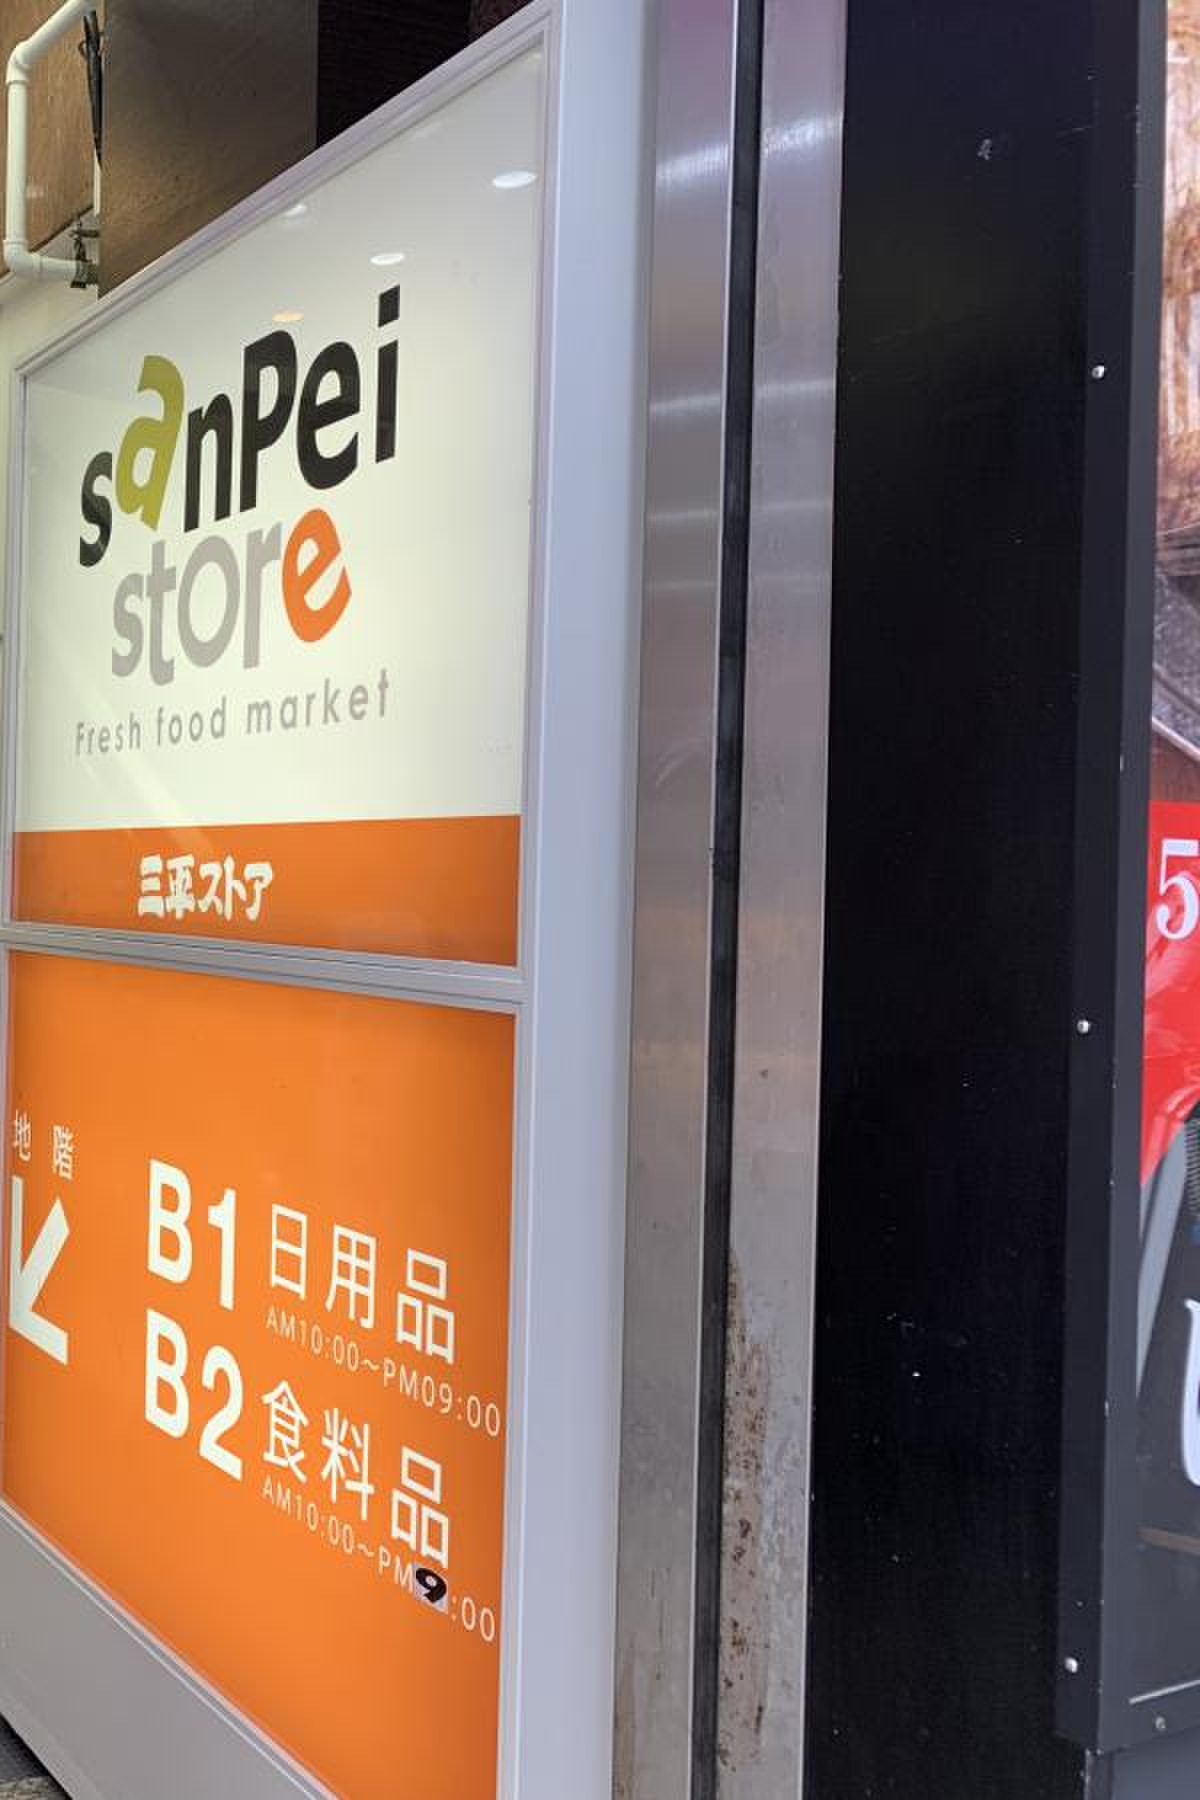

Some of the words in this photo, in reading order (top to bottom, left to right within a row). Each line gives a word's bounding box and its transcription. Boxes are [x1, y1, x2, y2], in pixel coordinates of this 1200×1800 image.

[112, 508, 352, 686] store
[75, 712, 141, 756] Fresh
[157, 696, 226, 746] food
[246, 668, 389, 735] market
[137, 853, 274, 921] 三平ストア
[13, 1109, 74, 1180] 地階
[147, 1159, 237, 1311] B1
[270, 1203, 456, 1365] 日用品
[144, 1308, 244, 1481] B2
[261, 1380, 450, 1569] 食料品
